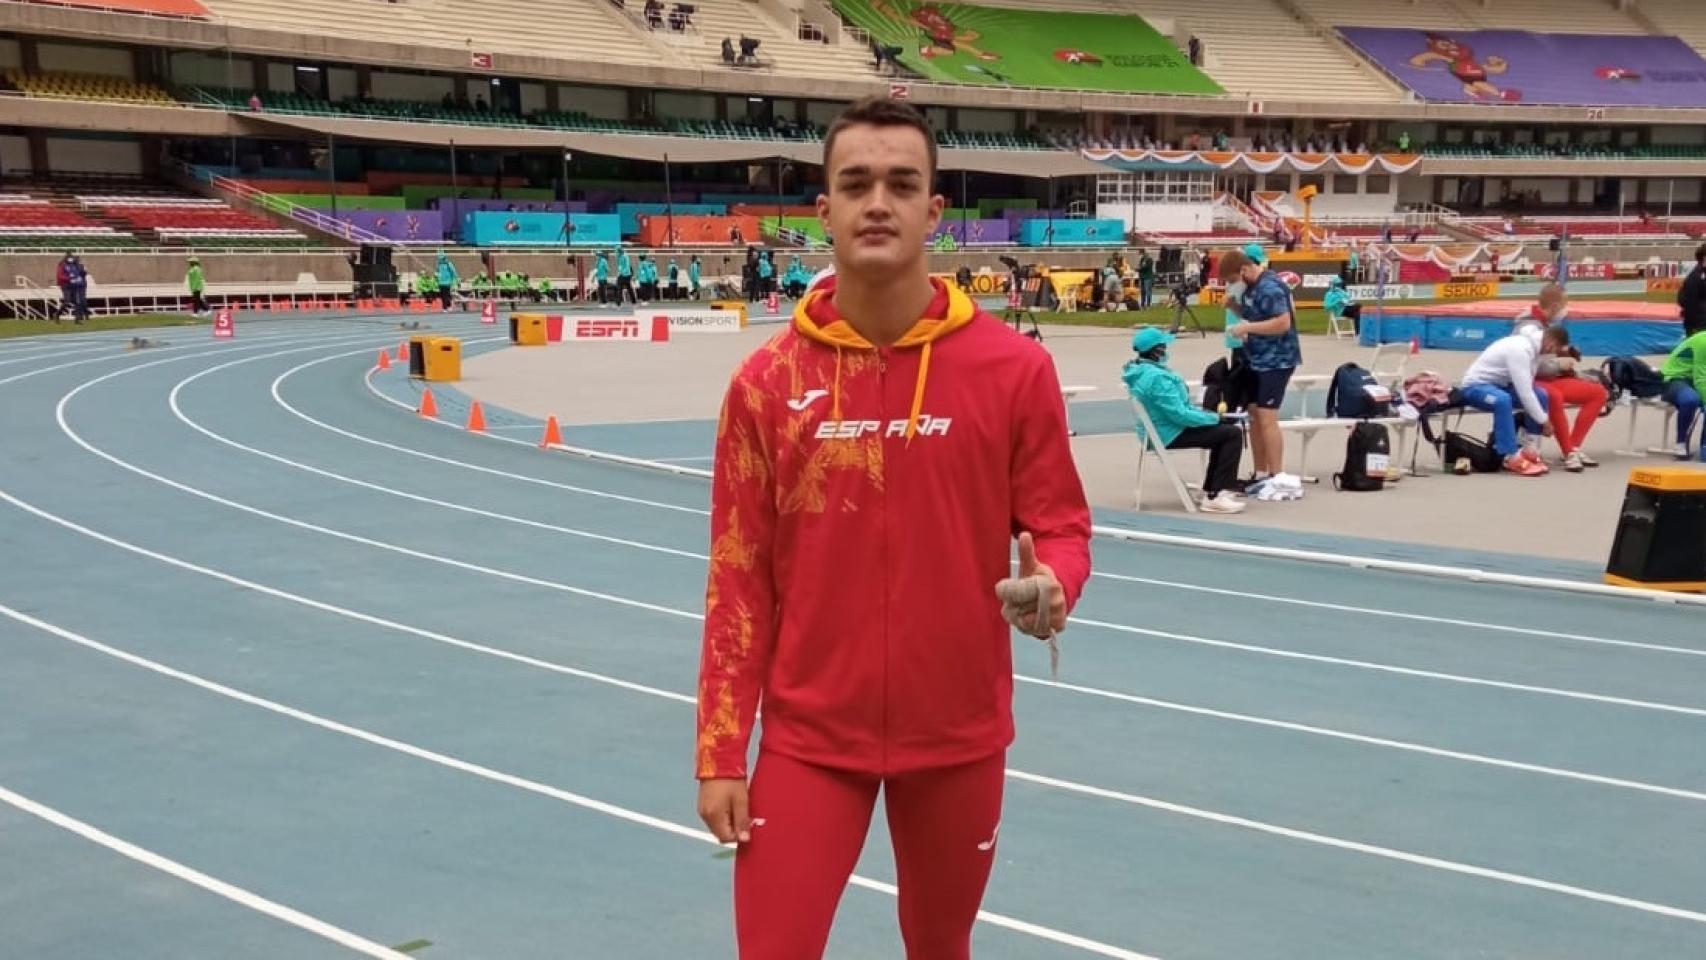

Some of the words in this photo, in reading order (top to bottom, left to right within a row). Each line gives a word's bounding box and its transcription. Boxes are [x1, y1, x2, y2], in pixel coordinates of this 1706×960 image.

[1444, 284, 1489, 298] SEIKO
[483, 302, 492, 315] 4
[219, 314, 228, 327] 5
[576, 320, 639, 337] ESPN
